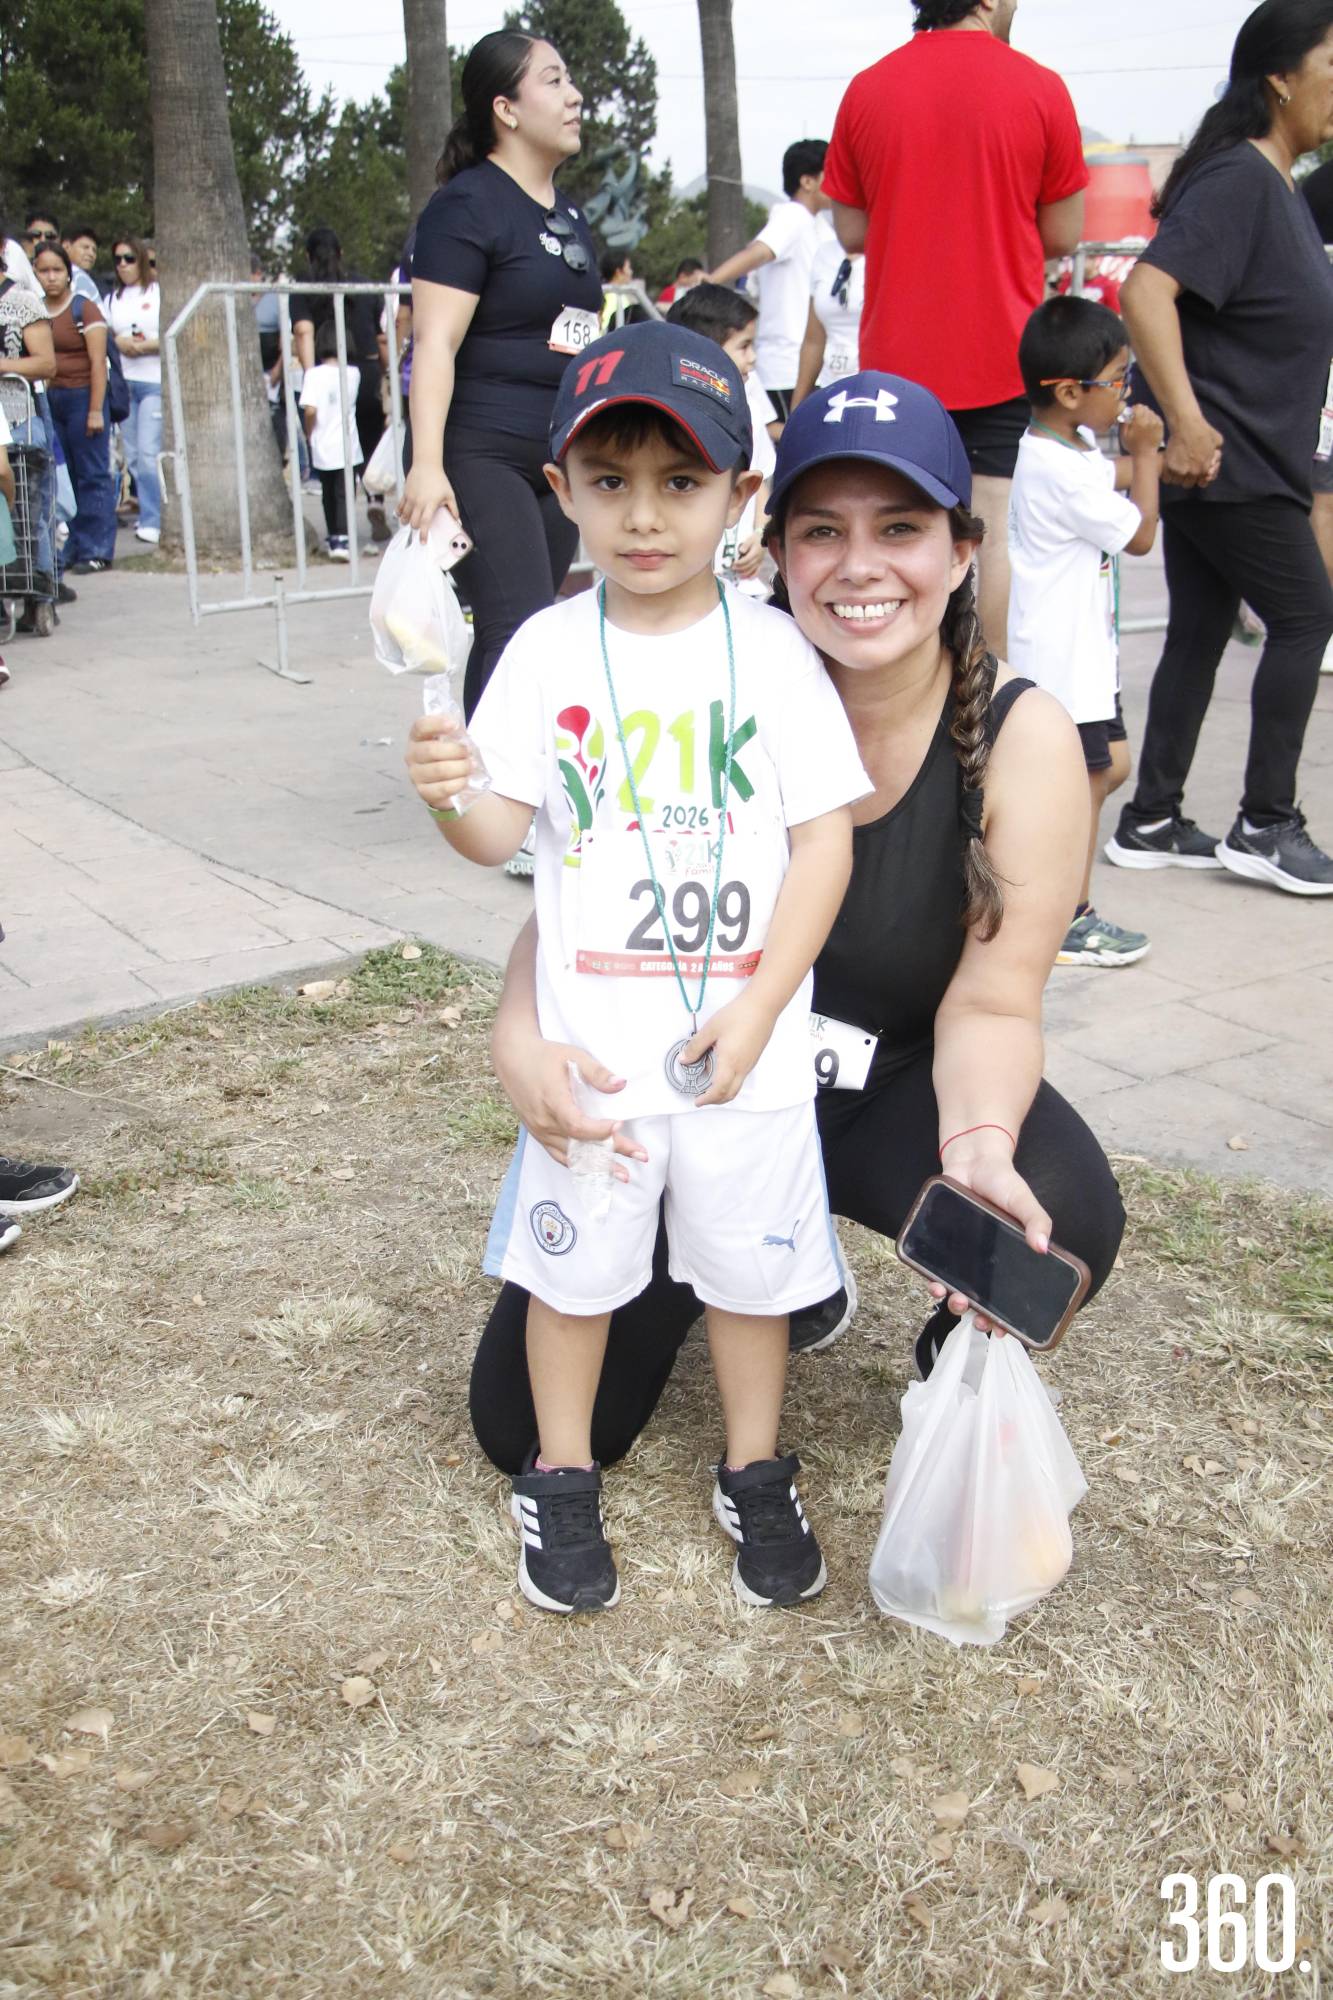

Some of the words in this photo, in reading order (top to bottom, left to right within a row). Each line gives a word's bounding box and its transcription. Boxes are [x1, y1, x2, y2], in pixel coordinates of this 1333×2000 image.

[563, 320, 591, 347] 158
[575, 350, 625, 398] 11
[679, 358, 729, 386] ORACLE
[615, 699, 758, 815] 21K
[662, 804, 709, 829] 2026
[624, 878, 751, 953] 299
